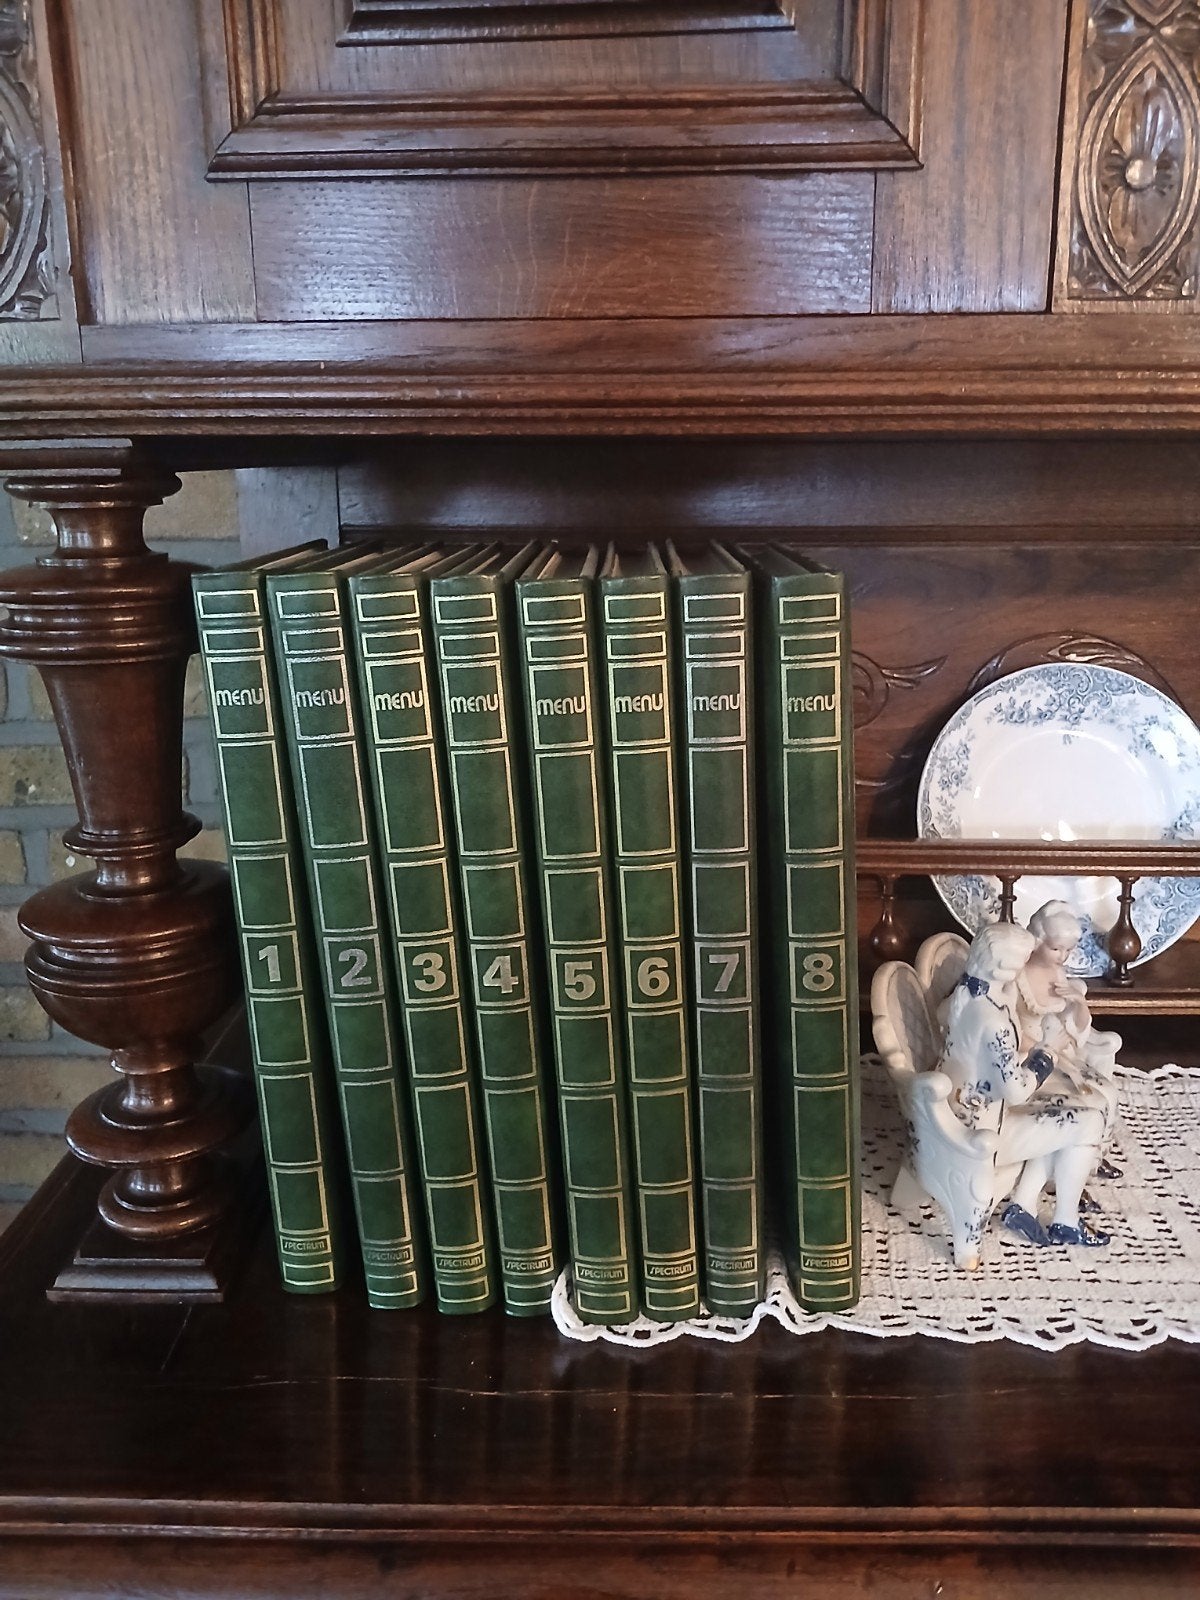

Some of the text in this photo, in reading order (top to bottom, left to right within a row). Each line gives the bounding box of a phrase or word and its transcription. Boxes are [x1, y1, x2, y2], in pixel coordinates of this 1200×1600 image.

[258, 945, 281, 982] 1
[338, 948, 372, 987] 2
[412, 952, 446, 992] 3
[482, 955, 519, 994] 4
[564, 960, 596, 1000] 5
[637, 957, 670, 997] 6
[708, 953, 740, 992] 7
[802, 953, 835, 992] 8
[284, 1239, 325, 1251] SPECTRUM
[438, 1256, 481, 1268] SPECTRUM
[804, 1256, 848, 1268] SPECTRUM
[506, 1258, 549, 1271] SPECTRUM
[580, 1268, 623, 1280] SPECTRUM
[650, 1264, 692, 1277] SPECTRUM
[710, 1259, 753, 1270] SPECTRUM
